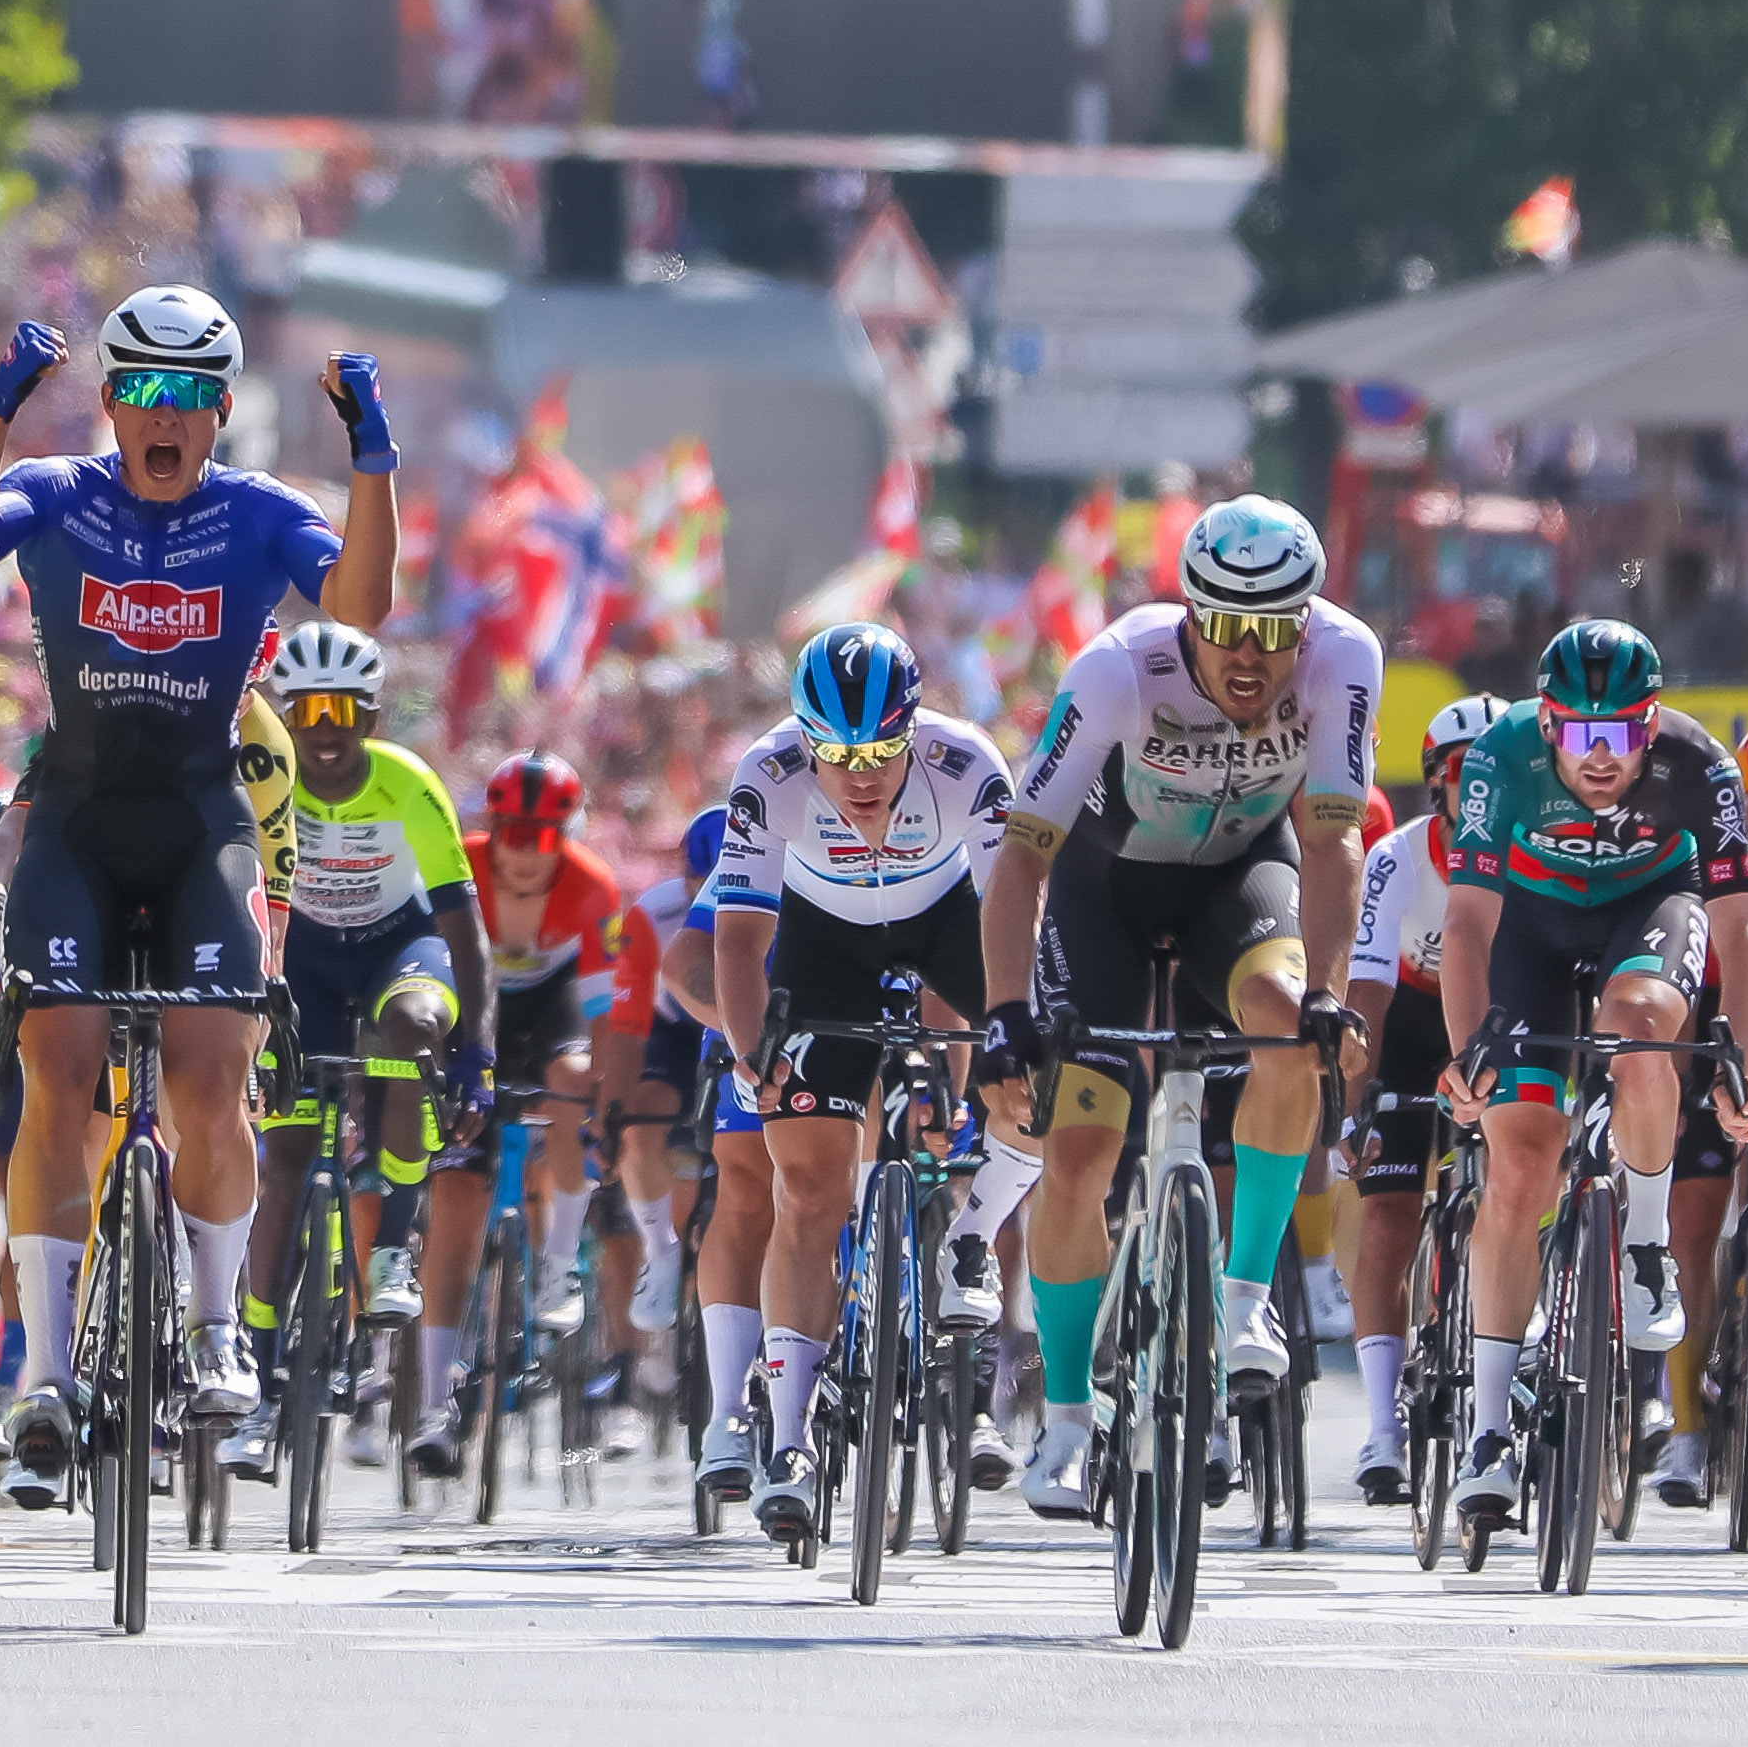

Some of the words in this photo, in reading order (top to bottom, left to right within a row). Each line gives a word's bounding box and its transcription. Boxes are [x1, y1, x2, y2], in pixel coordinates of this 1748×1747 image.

[187, 500, 232, 526] ZWIFT
[95, 589, 206, 632] Alpecin
[137, 625, 206, 637] BOOSTER
[78, 662, 211, 701] deceuninck
[110, 693, 176, 712] WINDOWS
[1025, 700, 1085, 803] MERIDA
[1142, 722, 1311, 763] BAHRAIN
[1345, 683, 1369, 789] MERIDA
[1530, 831, 1659, 856] BORA
[1355, 854, 1398, 946] Cofidis
[1048, 926, 1072, 982] BUSINESS
